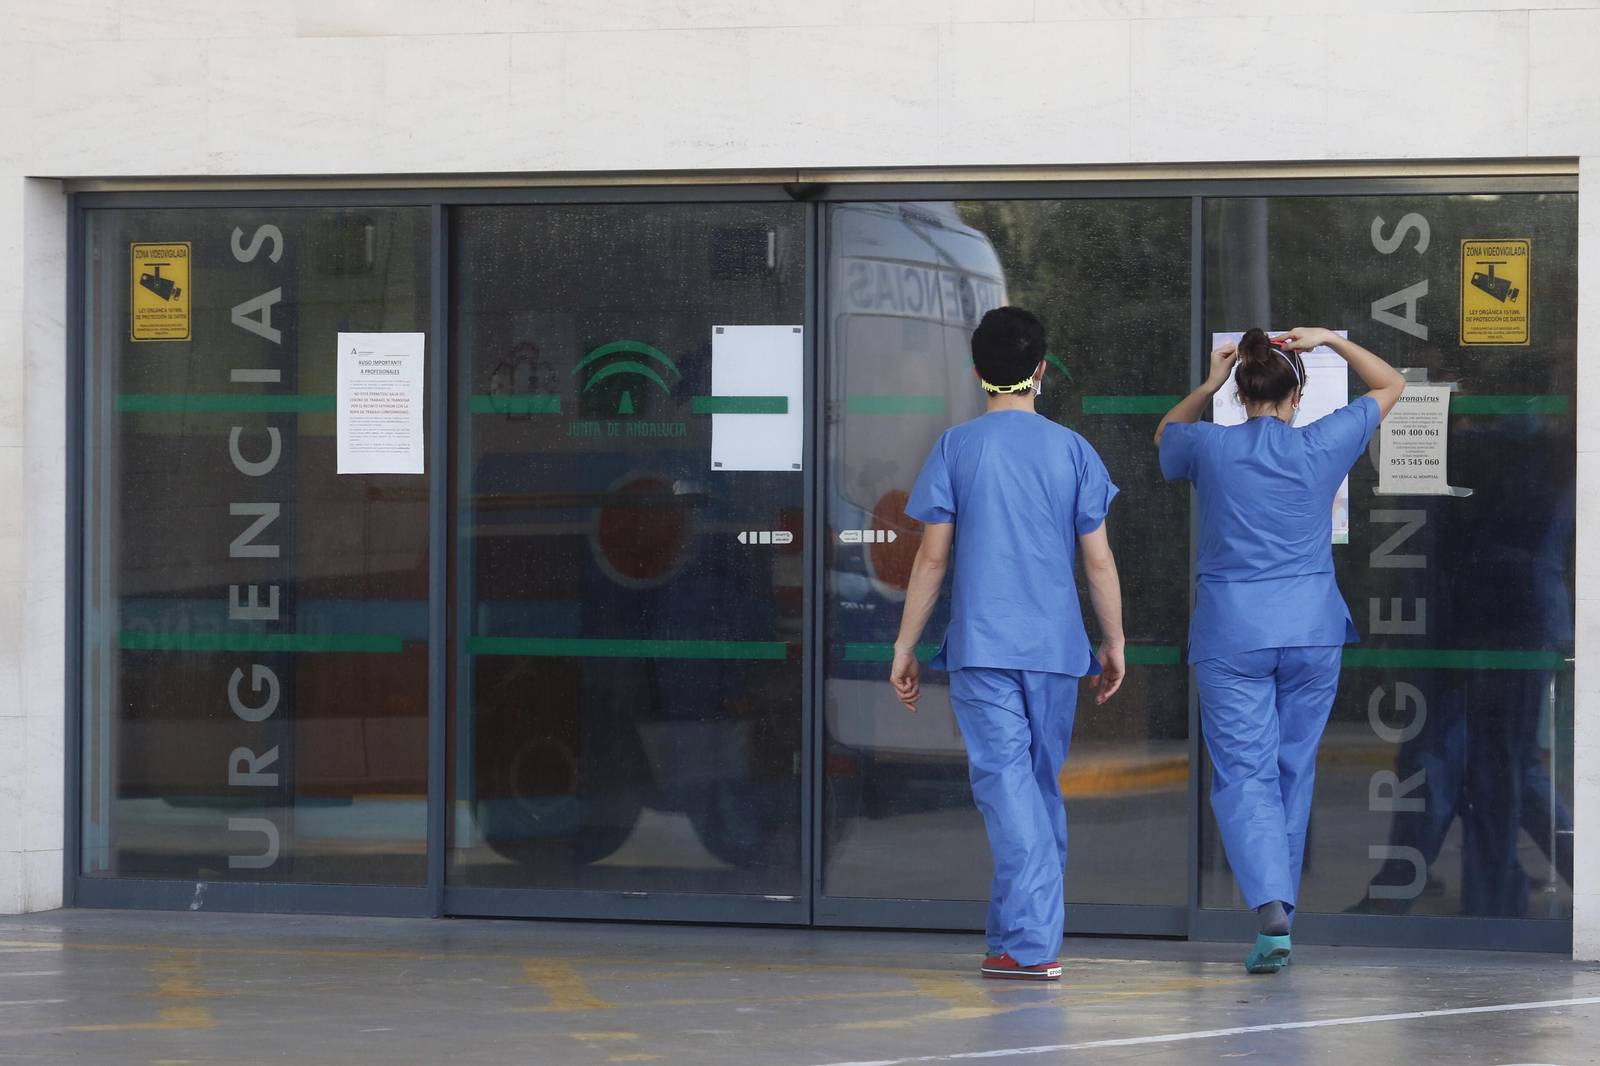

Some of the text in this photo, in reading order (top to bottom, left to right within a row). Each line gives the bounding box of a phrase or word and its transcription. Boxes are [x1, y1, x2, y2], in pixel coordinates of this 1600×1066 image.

[136, 250, 186, 258] ZONA VIDEOVIGILADA
[1466, 247, 1526, 256] ZONA VIDEOVIGILADA
[566, 422, 686, 436] JUNTA DE ANDALUCIA
[228, 224, 283, 869] URGENCIAS
[1367, 212, 1430, 899] URGENIAS
